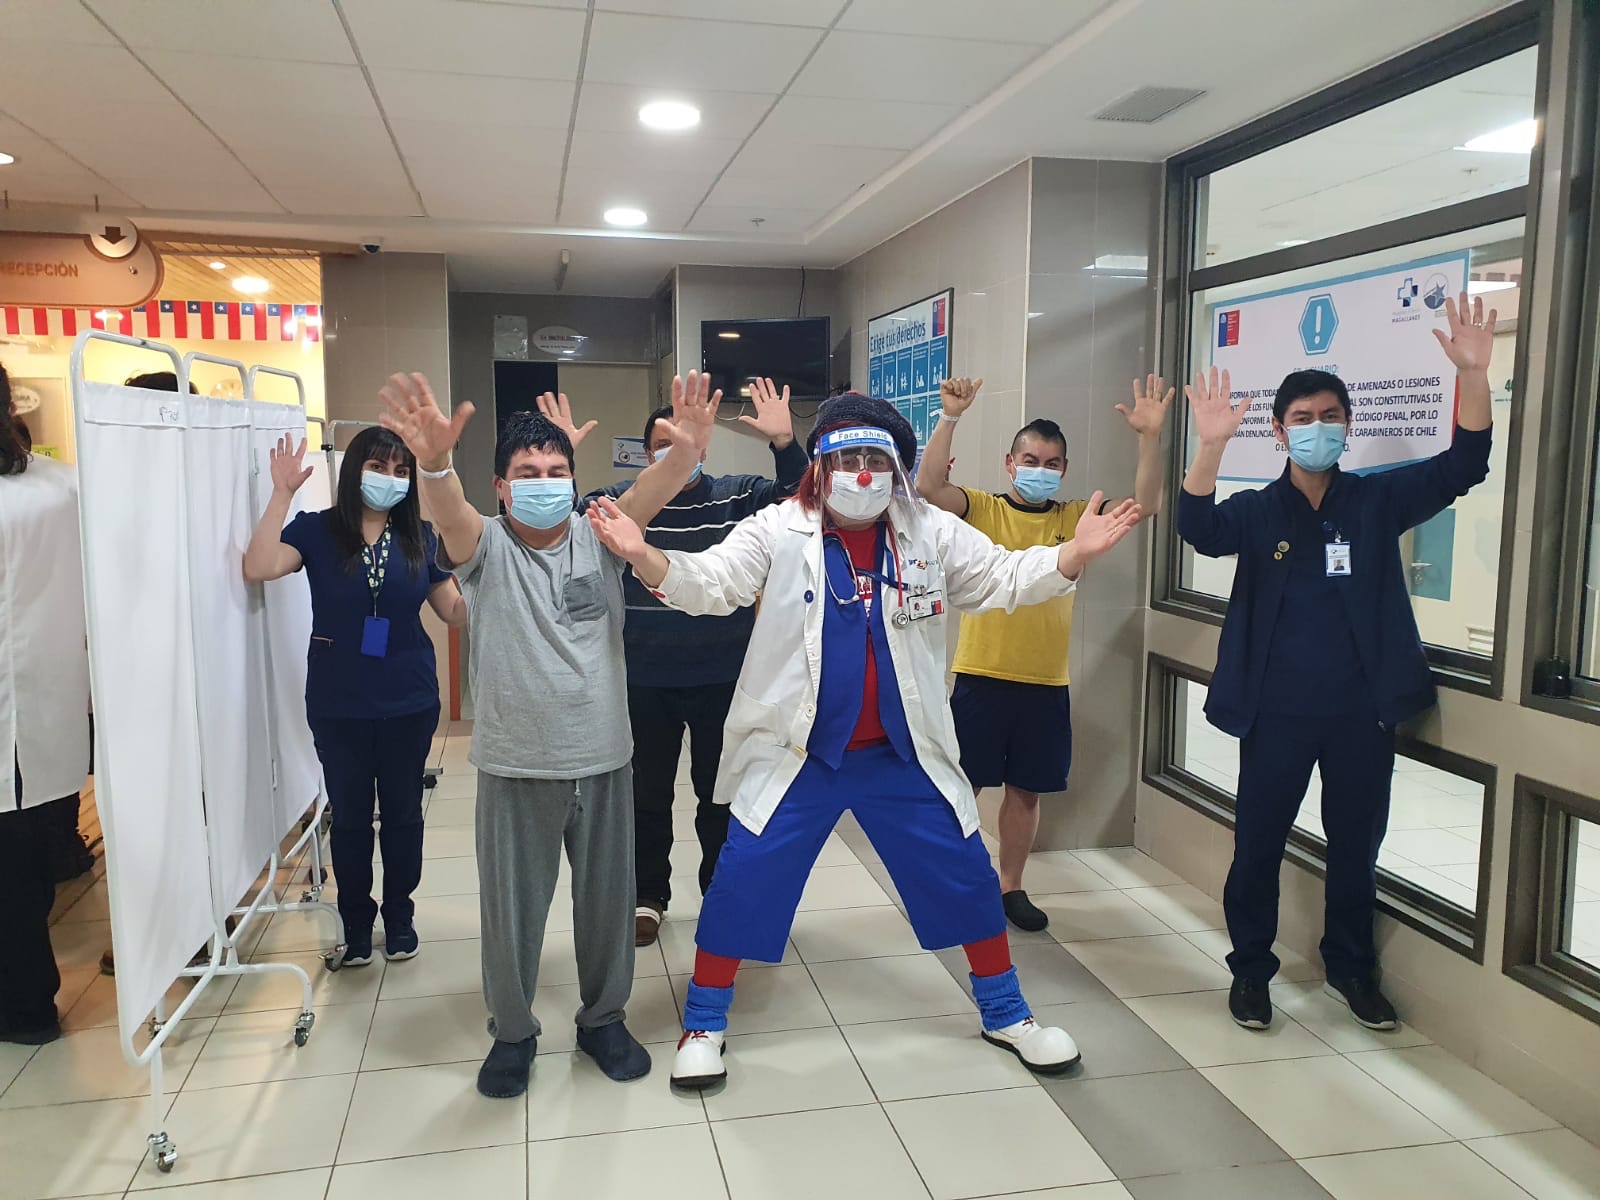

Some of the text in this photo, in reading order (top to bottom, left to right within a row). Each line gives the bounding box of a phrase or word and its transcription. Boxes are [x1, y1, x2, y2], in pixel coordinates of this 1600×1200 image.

[870, 321, 926, 354] Exige tus derechos
[1347, 377, 1440, 392] DE AMENAZAS O LESIONES
[1250, 389, 1261, 398] QUE
[1359, 397, 1373, 407] SON
[1374, 393, 1431, 406] CONSTITUTIVAS
[1432, 393, 1443, 403] DE
[1252, 402, 1262, 412] LOS
[1355, 409, 1439, 422] CÓDIGO PENAL, POR LO
[838, 432, 859, 440] Face
[1355, 427, 1403, 437] CARABINEROS
[1404, 427, 1415, 437] DE
[1416, 426, 1437, 437] CHILE
